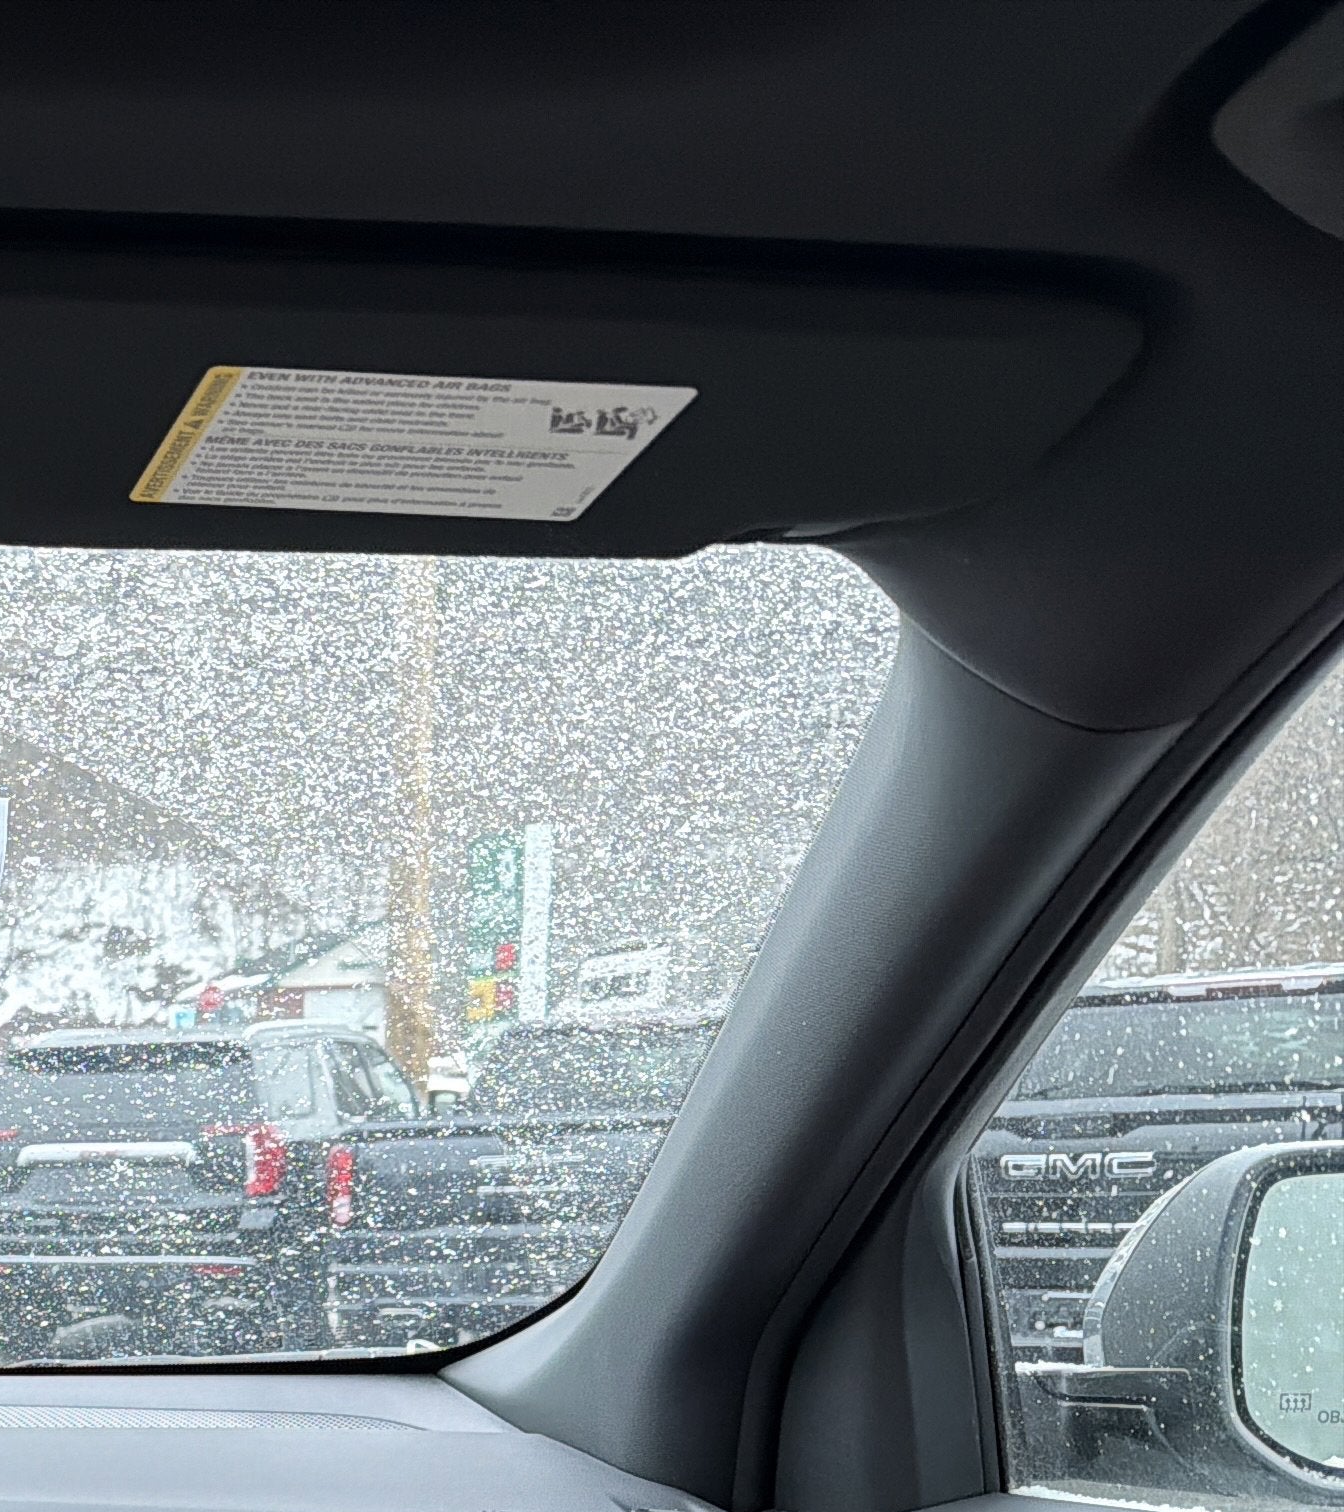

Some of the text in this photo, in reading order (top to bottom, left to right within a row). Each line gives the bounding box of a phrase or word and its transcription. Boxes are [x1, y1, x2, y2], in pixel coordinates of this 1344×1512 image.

[294, 373, 337, 383] WITH
[340, 375, 431, 388] ADVANCED
[1000, 1151, 1158, 1181] GMC
